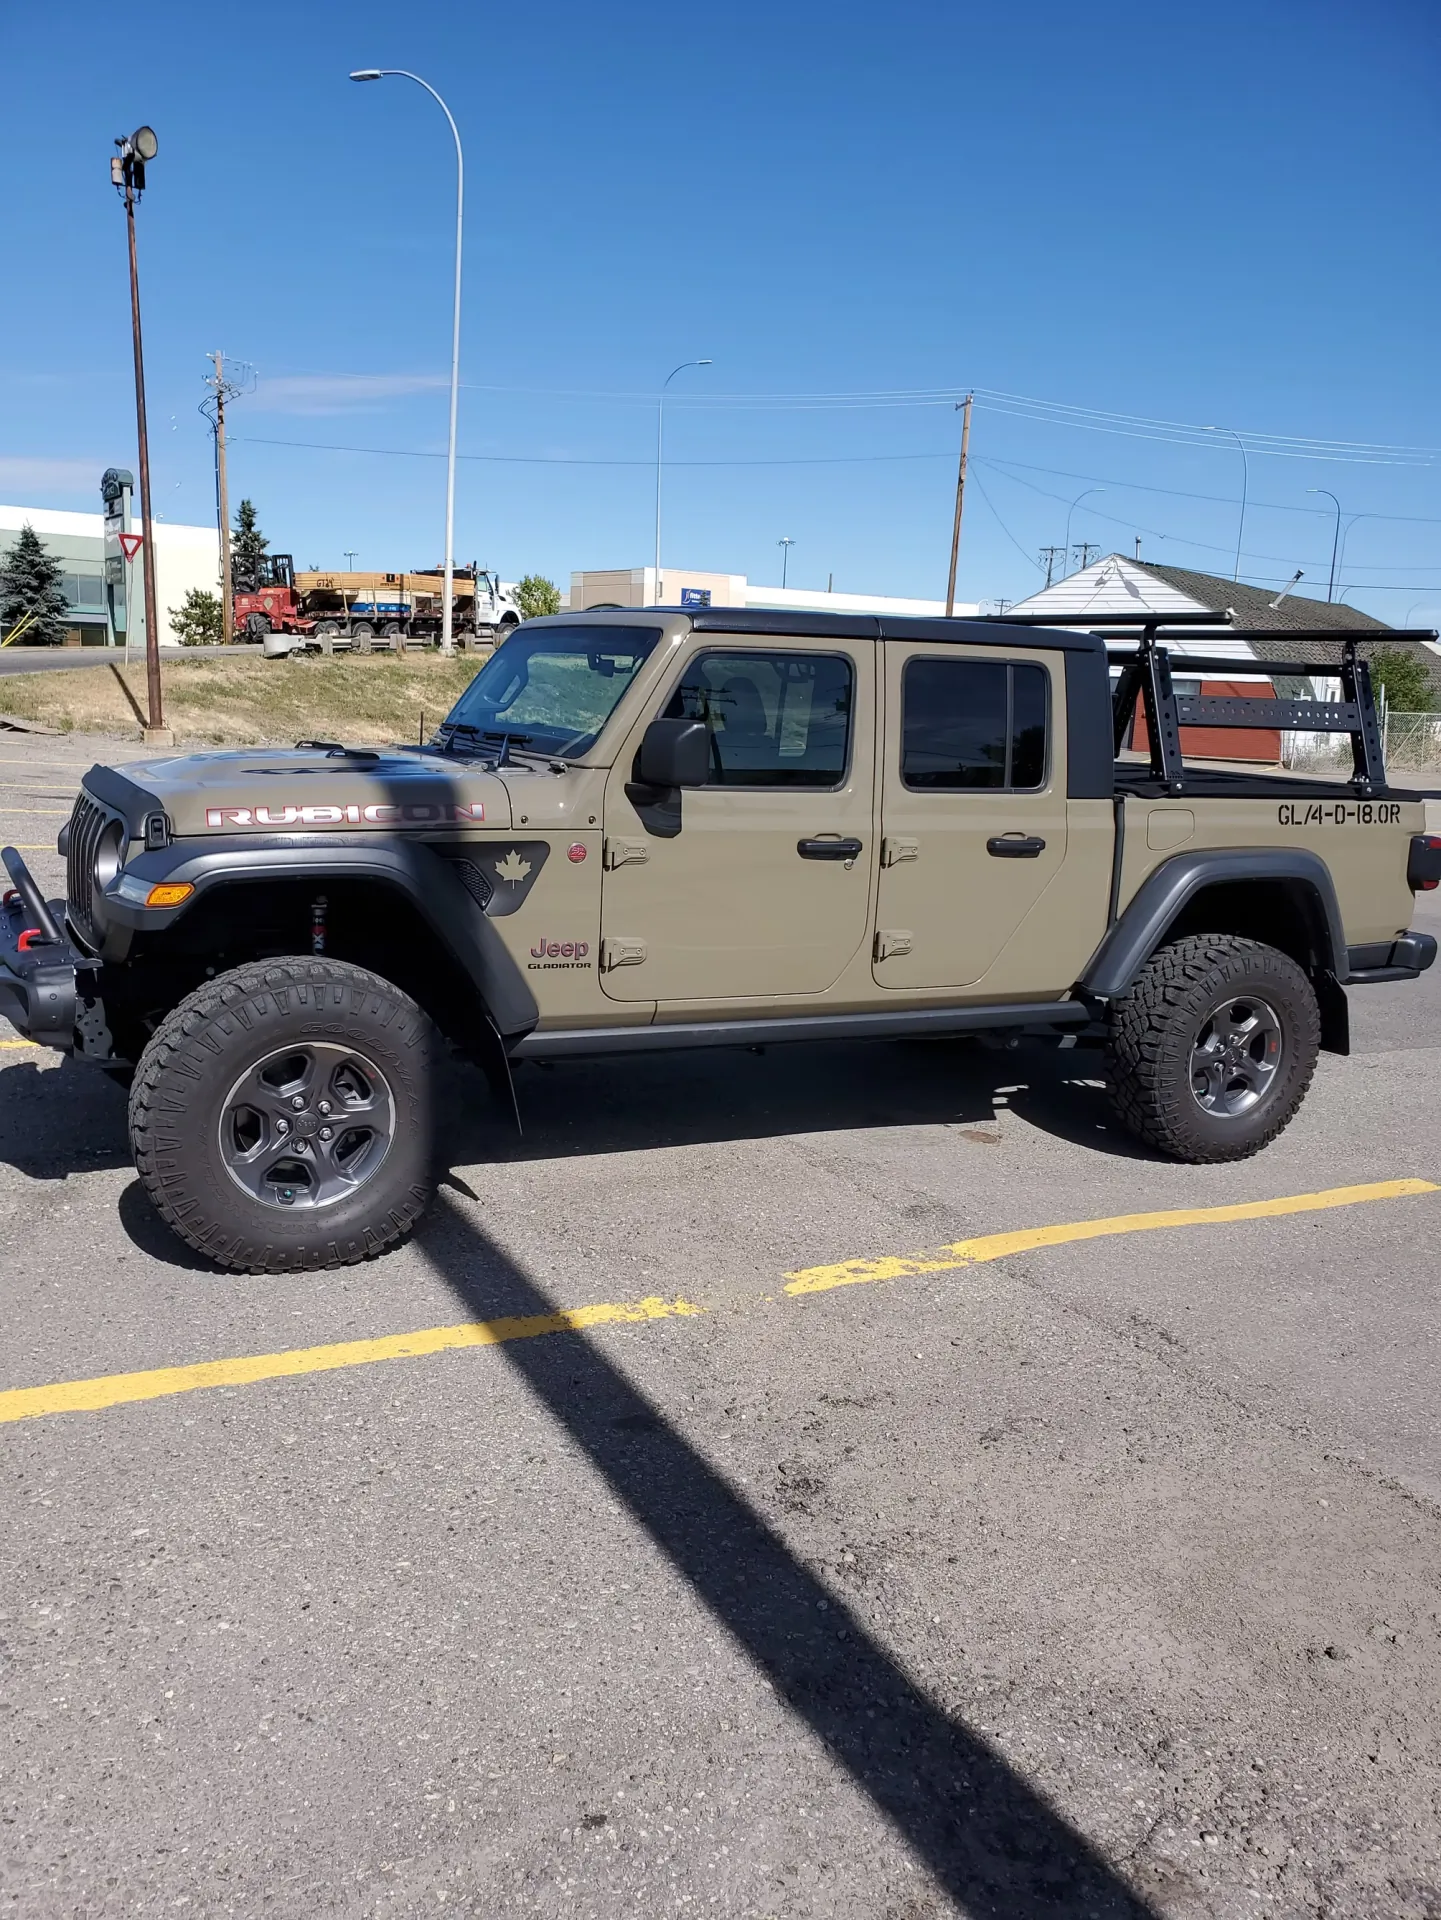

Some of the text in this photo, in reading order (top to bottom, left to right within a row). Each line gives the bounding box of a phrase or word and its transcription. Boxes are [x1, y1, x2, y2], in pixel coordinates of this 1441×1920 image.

[206, 802, 485, 828] RUBICON
[530, 938, 589, 961] Jeep
[527, 962, 592, 970] GLADIATOR
